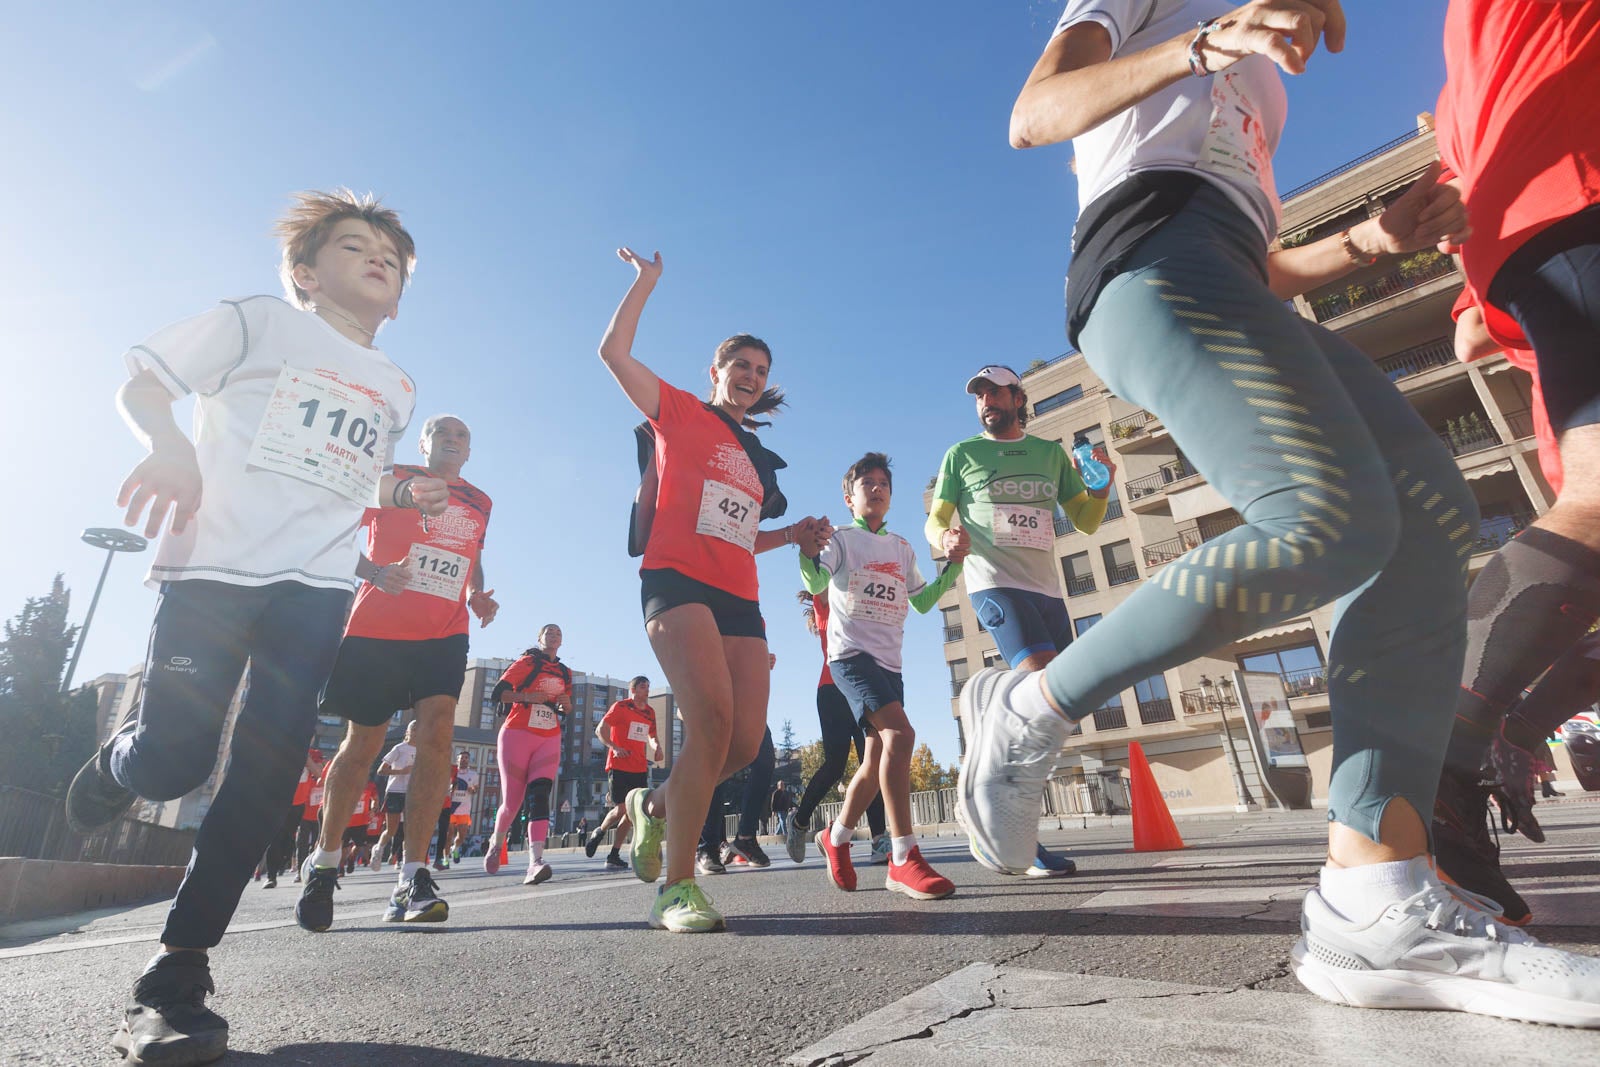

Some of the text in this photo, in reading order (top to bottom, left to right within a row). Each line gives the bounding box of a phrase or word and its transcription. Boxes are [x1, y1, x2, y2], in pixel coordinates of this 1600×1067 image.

[298, 399, 377, 458] 1102
[325, 442, 358, 465] MARTIN
[985, 479, 1058, 500] segro
[718, 498, 749, 523] 427
[1008, 513, 1038, 529] 426
[418, 555, 459, 578] 1120
[863, 582, 896, 602] 425
